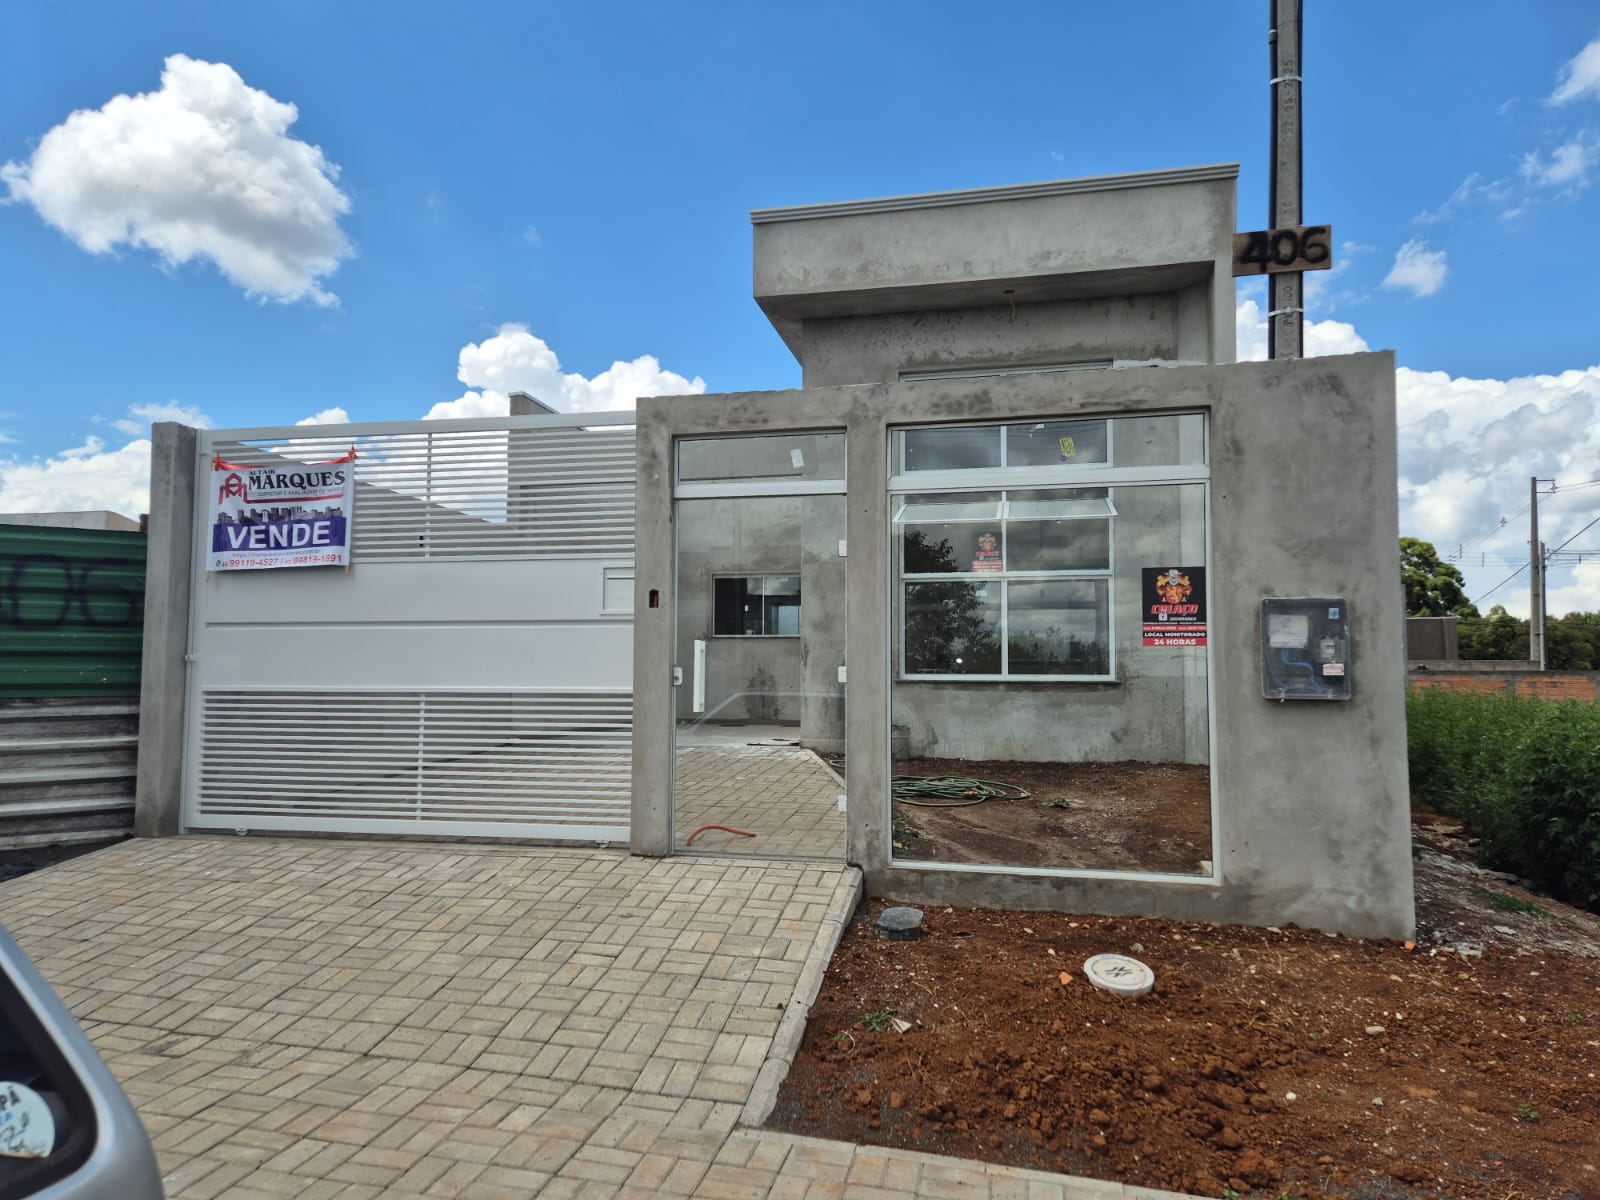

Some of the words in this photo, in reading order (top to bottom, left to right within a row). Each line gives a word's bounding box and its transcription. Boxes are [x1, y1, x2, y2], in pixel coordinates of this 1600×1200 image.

[1239, 226, 1329, 273] 406
[249, 471, 346, 490] MARQUES
[227, 521, 331, 549] VENDE
